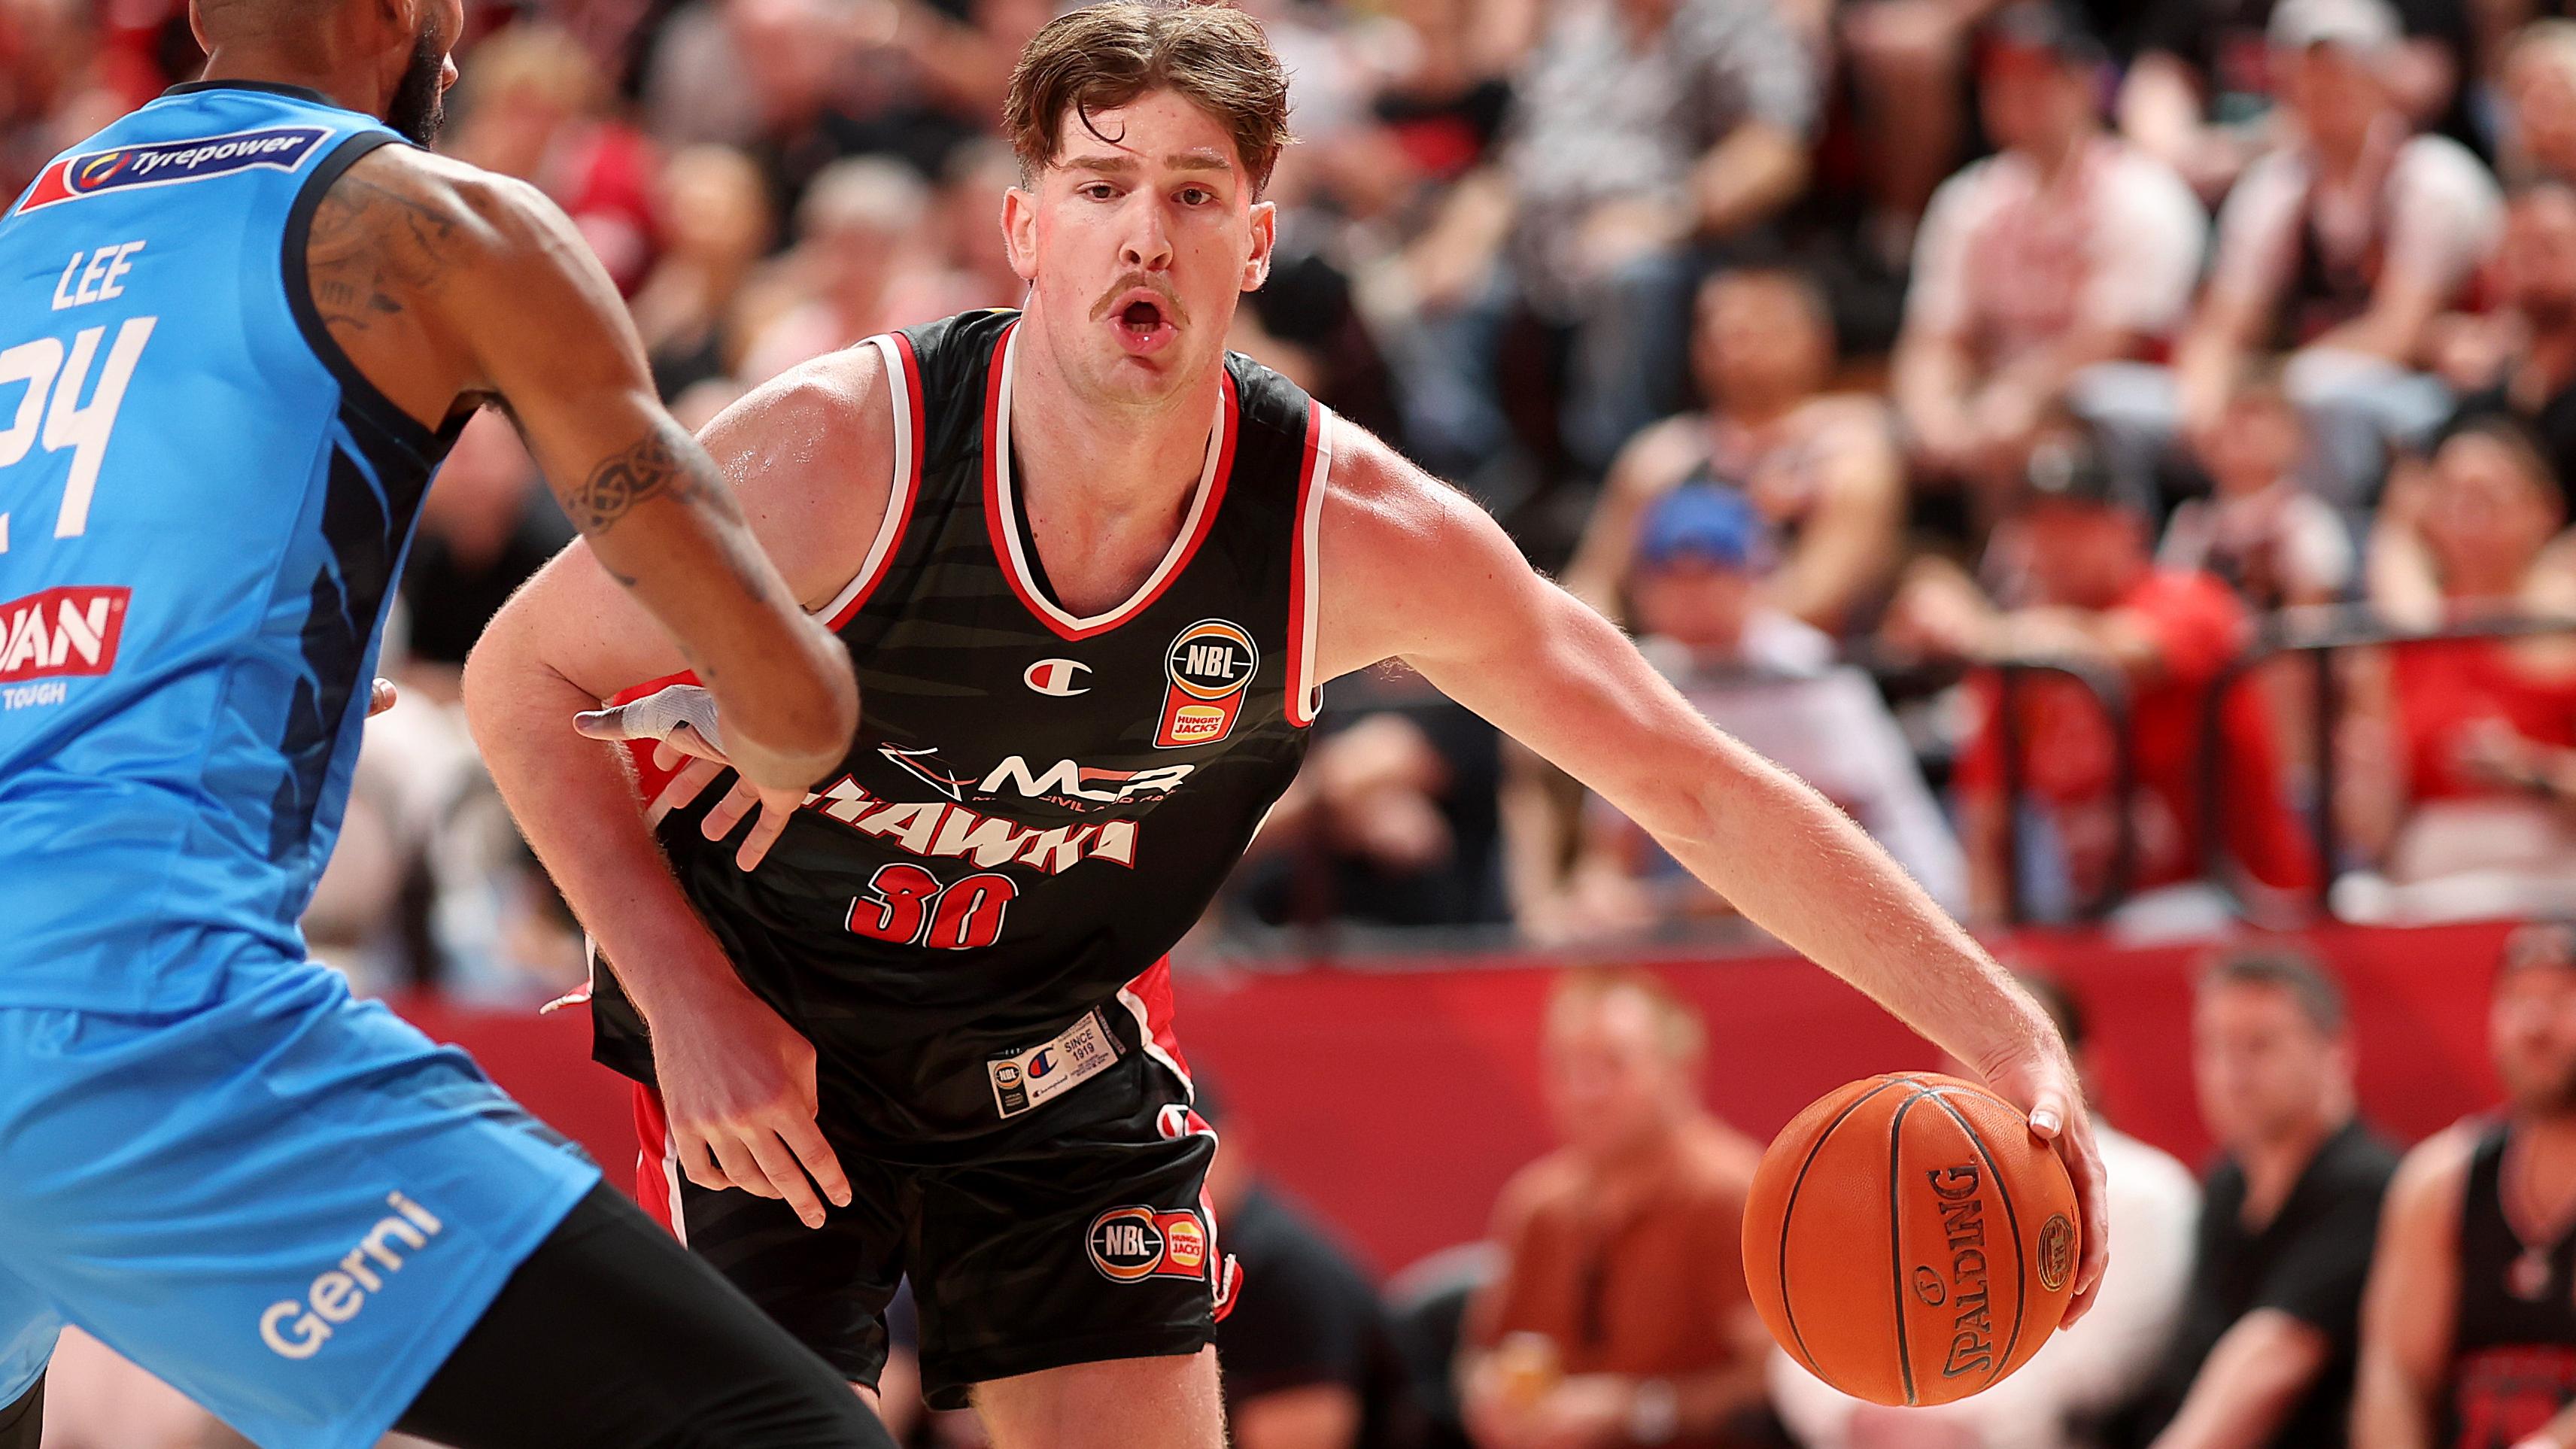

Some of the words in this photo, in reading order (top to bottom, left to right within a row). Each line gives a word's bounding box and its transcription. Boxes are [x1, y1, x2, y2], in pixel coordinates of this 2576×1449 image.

[131, 135, 305, 175] Tyrepower
[52, 240, 147, 311] LEE
[1185, 644, 1235, 679] NBL
[2, 682, 66, 710] TOUGH
[1177, 715, 1221, 724] HUNGRY
[978, 755, 1195, 802] MCR
[845, 863, 1019, 950] 30
[1065, 1028, 1093, 1053] SINCE
[1073, 1042, 1095, 1061] 1919
[999, 1068, 1016, 1081] NBL
[1105, 1226, 1150, 1256] NBL
[260, 1190, 442, 1359] Gerni
[1926, 1166, 1992, 1378] SPALDING
